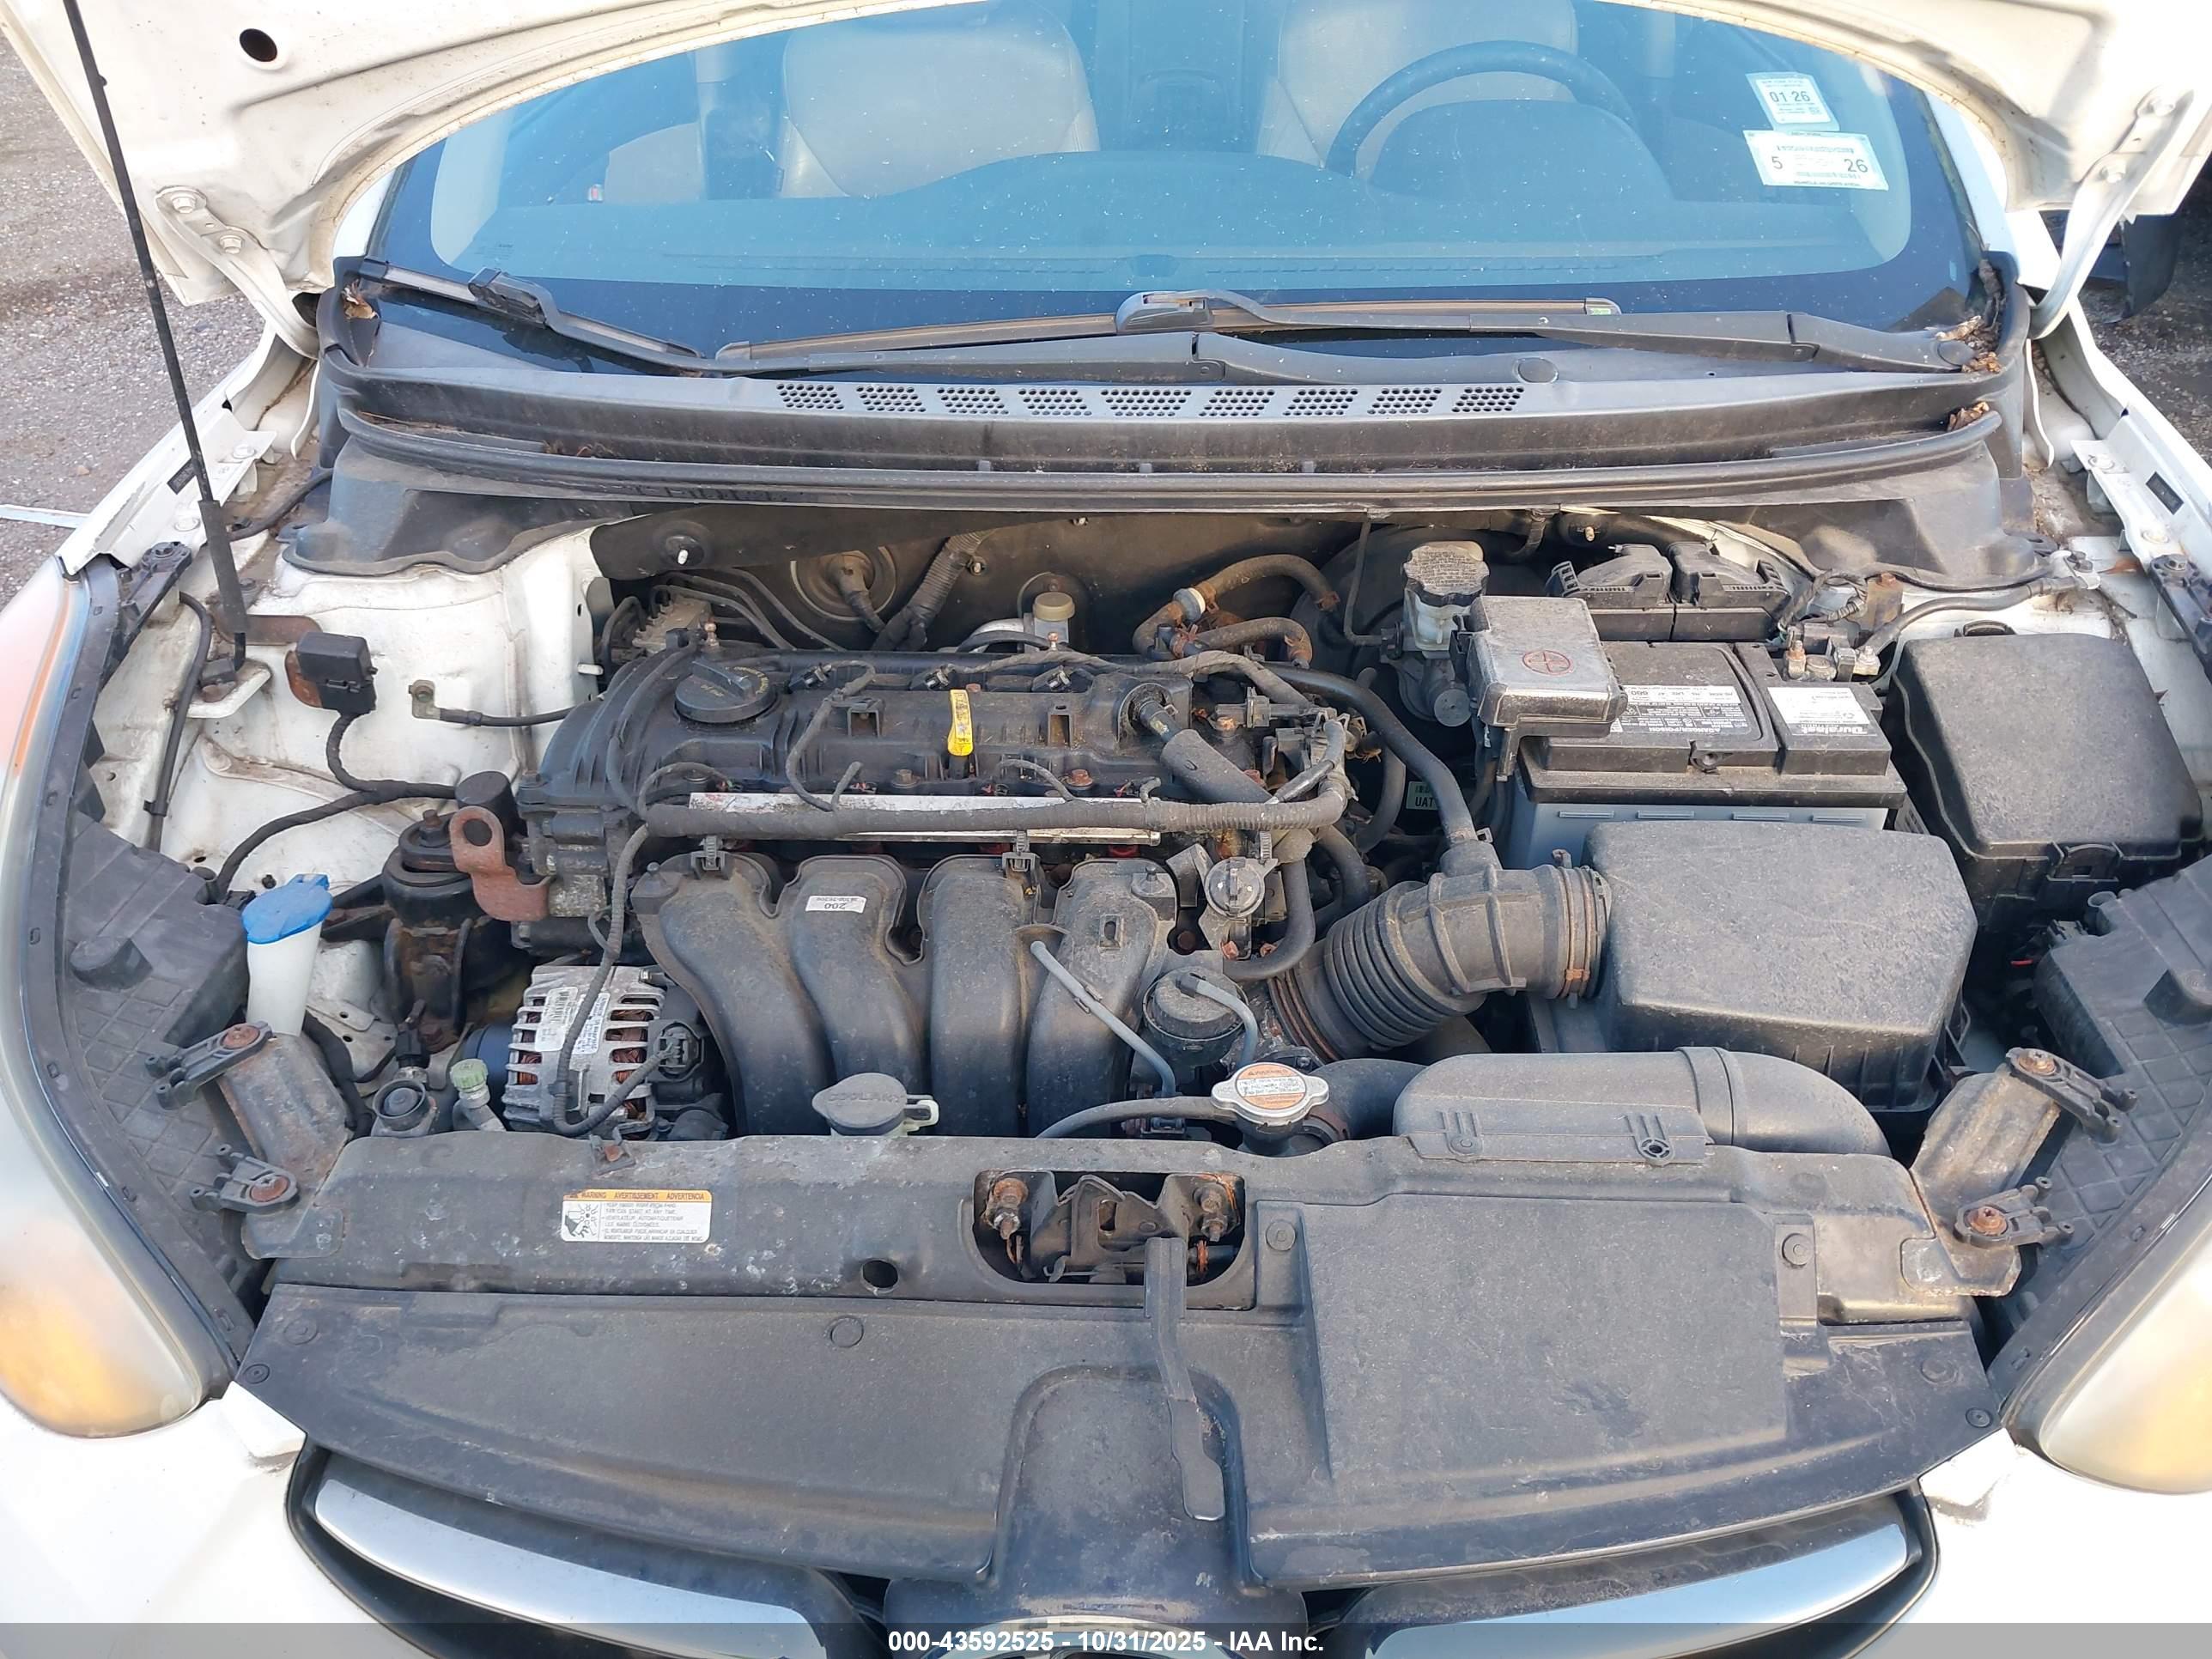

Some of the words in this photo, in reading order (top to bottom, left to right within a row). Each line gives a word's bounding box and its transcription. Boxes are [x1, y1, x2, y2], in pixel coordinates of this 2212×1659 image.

[1769, 90, 1788, 102] 01
[1791, 90, 1811, 102] 26
[1771, 155, 1784, 169] 5
[1844, 158, 1869, 173] 26
[1801, 726, 1868, 734] Duralast
